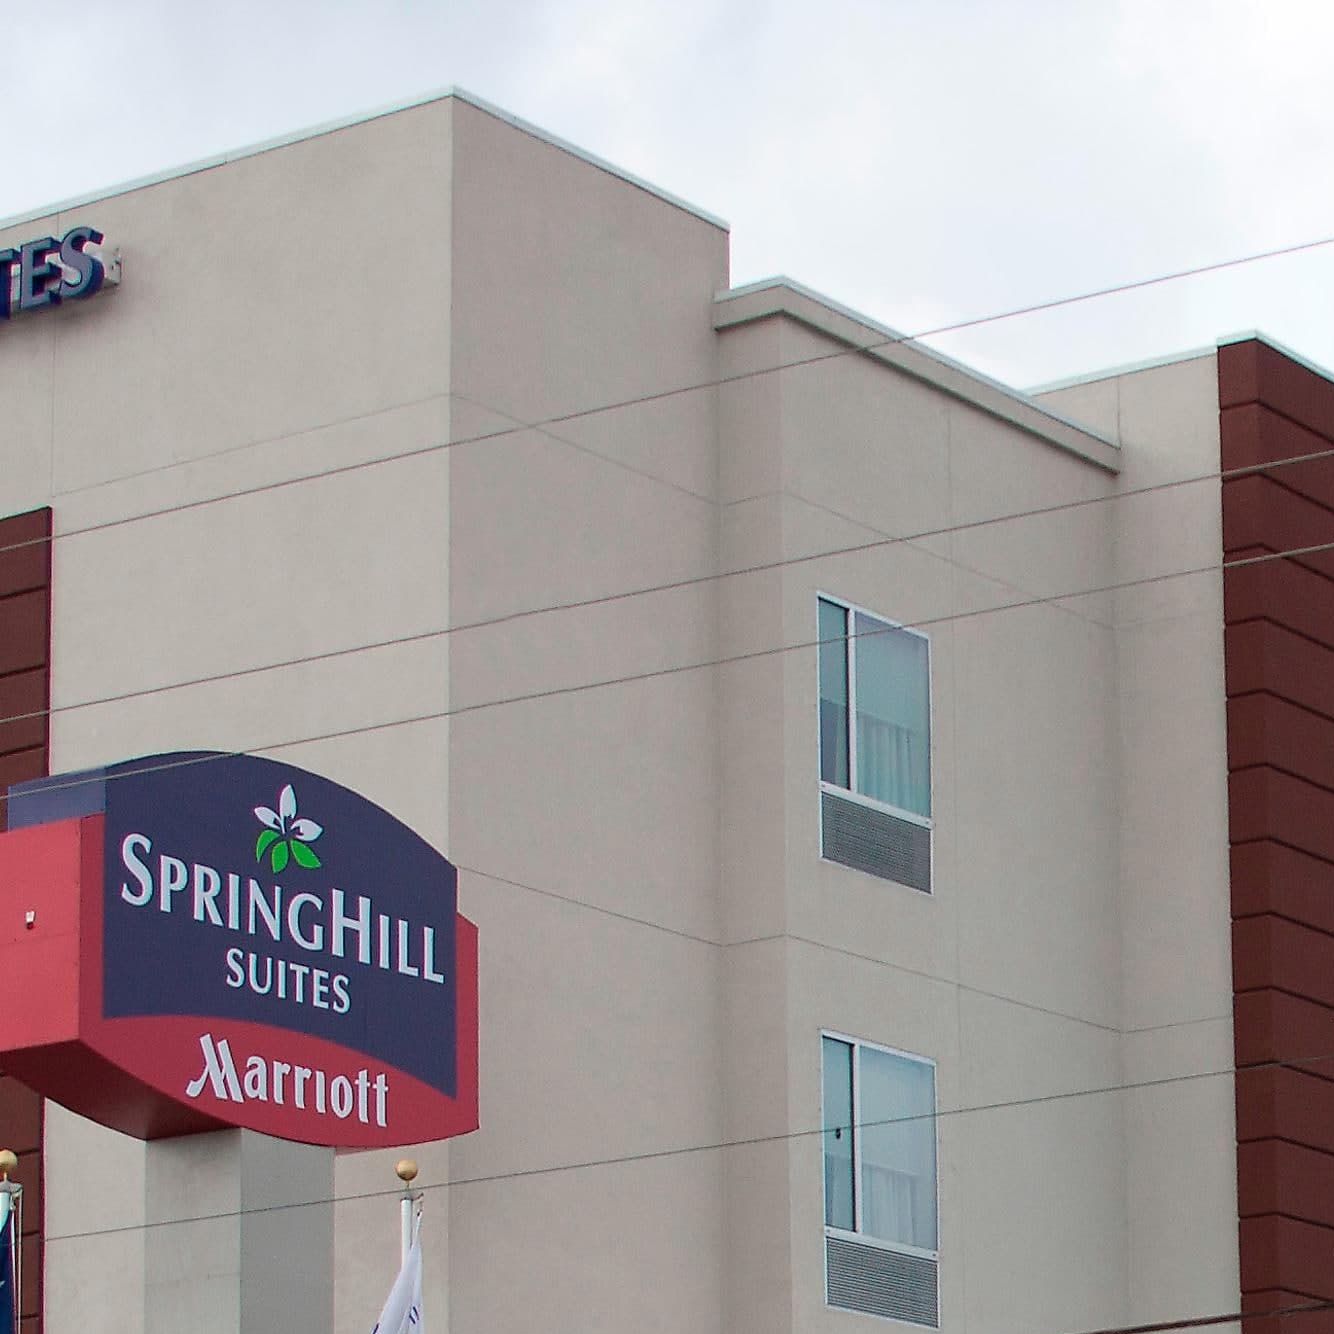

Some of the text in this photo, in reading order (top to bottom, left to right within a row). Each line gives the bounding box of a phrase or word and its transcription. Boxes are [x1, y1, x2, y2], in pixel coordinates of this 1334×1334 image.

[121, 833, 445, 984] SPRINGHILL
[226, 947, 351, 1014] SUITES
[186, 1033, 389, 1127] Marriott
